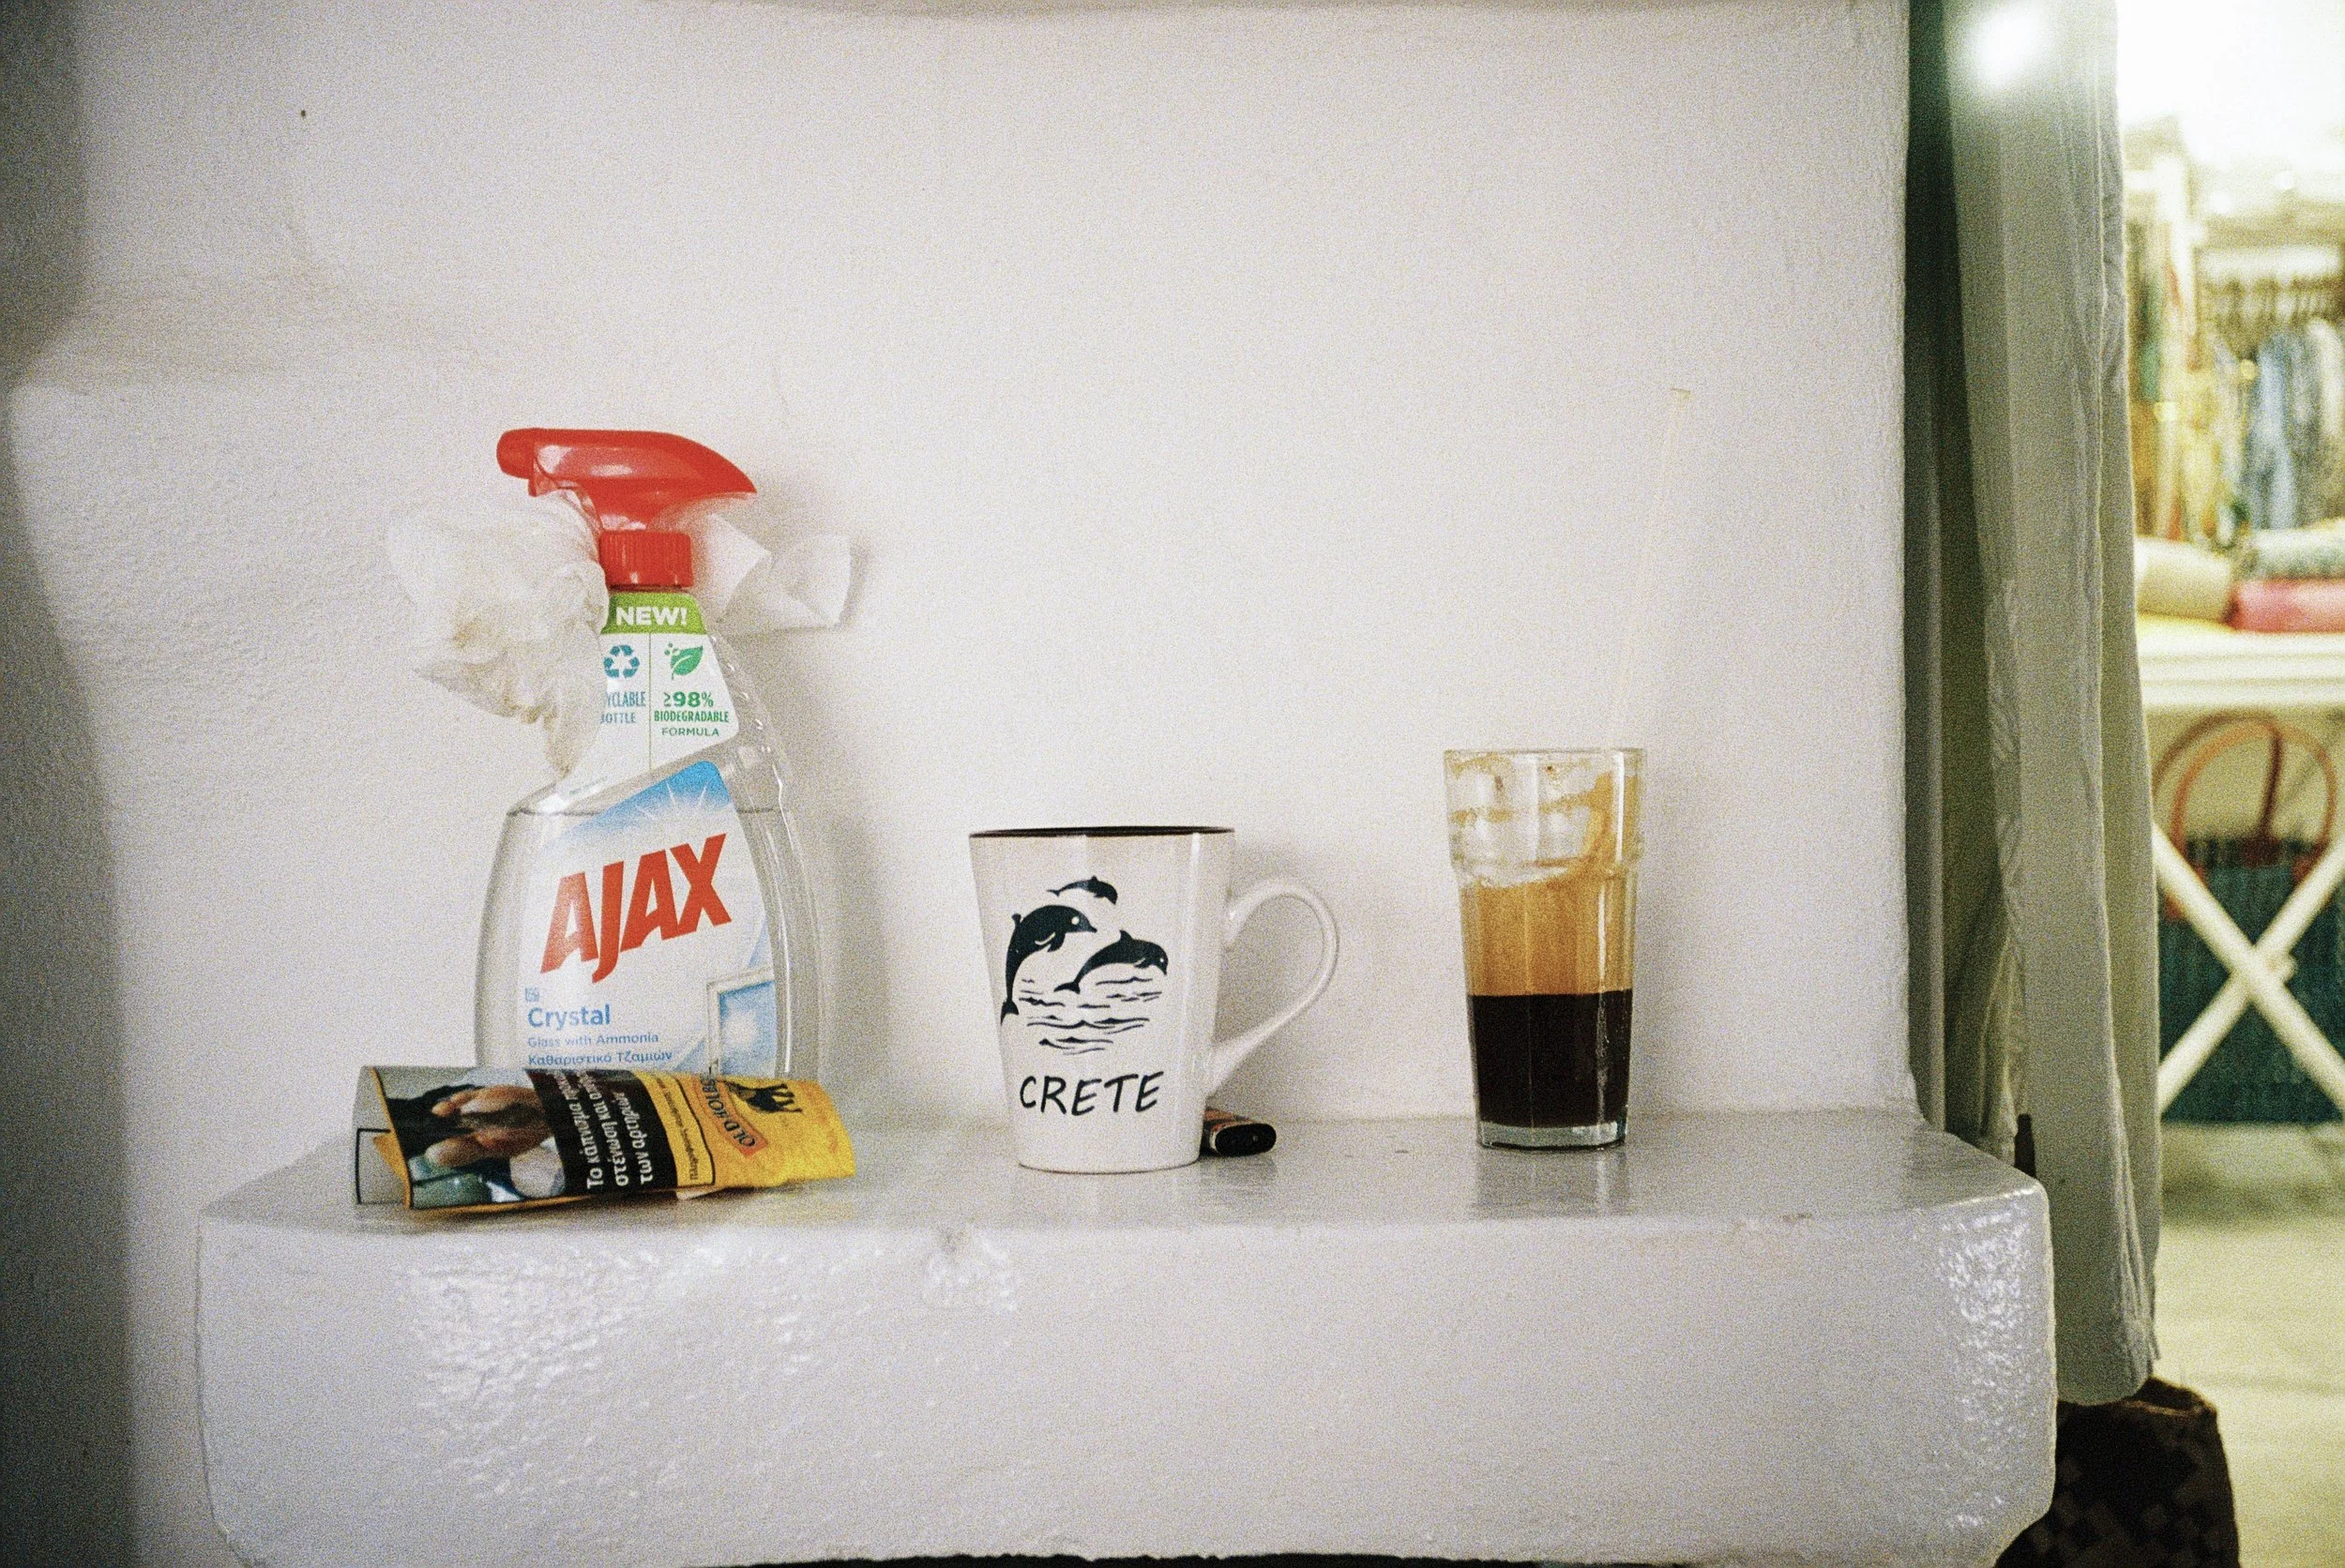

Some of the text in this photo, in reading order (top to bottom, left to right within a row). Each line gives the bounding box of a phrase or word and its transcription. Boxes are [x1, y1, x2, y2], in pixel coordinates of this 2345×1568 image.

[615, 606, 688, 626] NEW!
[606, 690, 646, 707] YCLABLE
[654, 710, 730, 723] BIODEGRADABLE
[661, 727, 719, 736] FORMULA
[540, 833, 733, 984] AJAX
[527, 1003, 611, 1031] Crystal
[527, 1033, 659, 1048] Glass with Ammonia
[1020, 1071, 1164, 1116] CRETE
